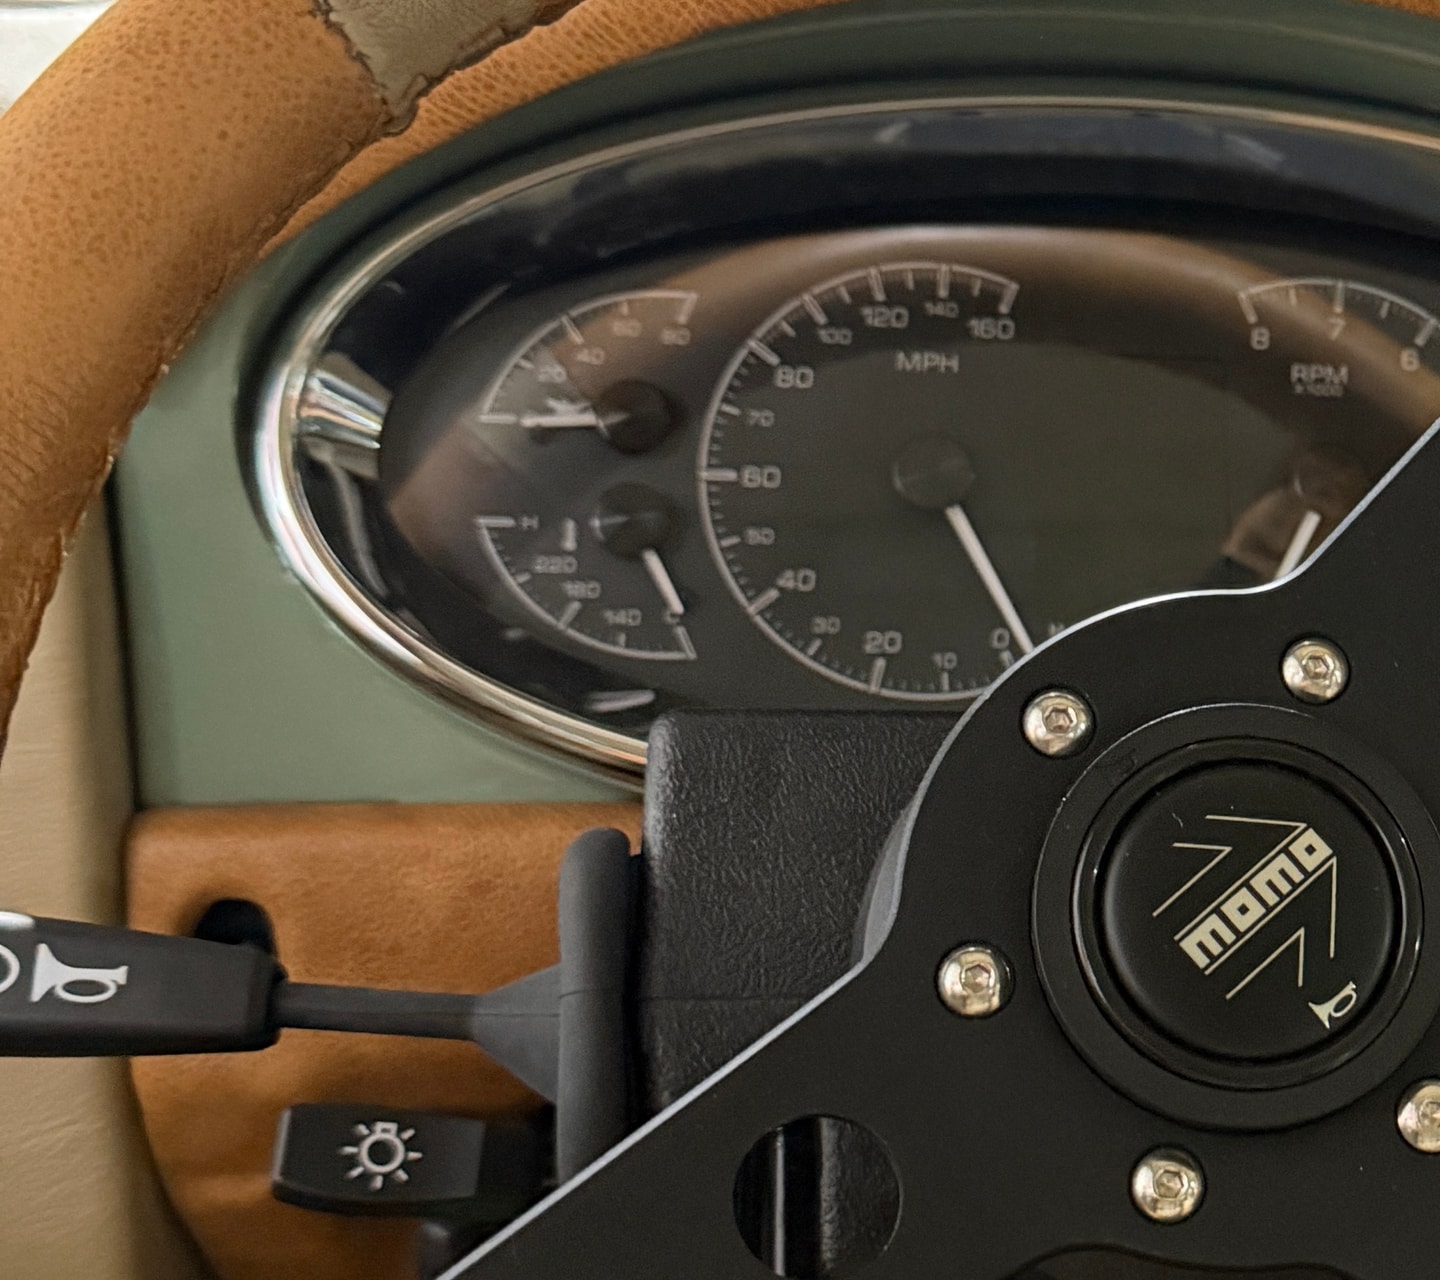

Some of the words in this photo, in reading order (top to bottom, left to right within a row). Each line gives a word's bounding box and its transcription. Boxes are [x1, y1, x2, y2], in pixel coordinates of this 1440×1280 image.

[861, 306, 909, 329] 120
[967, 317, 1015, 340] 160
[817, 327, 852, 345] 100
[1251, 326, 1270, 350] 8
[1328, 318, 1346, 341] 7
[895, 351, 959, 373] MPH
[1400, 348, 1420, 371] 6
[774, 366, 814, 389] 80
[1290, 362, 1349, 384] RPM
[747, 409, 775, 427] 70
[740, 465, 781, 489] 60
[776, 568, 817, 592] 40
[864, 630, 902, 655] 20
[991, 627, 1010, 649] 0
[933, 652, 957, 670] 10
[1179, 827, 1333, 969] momo
